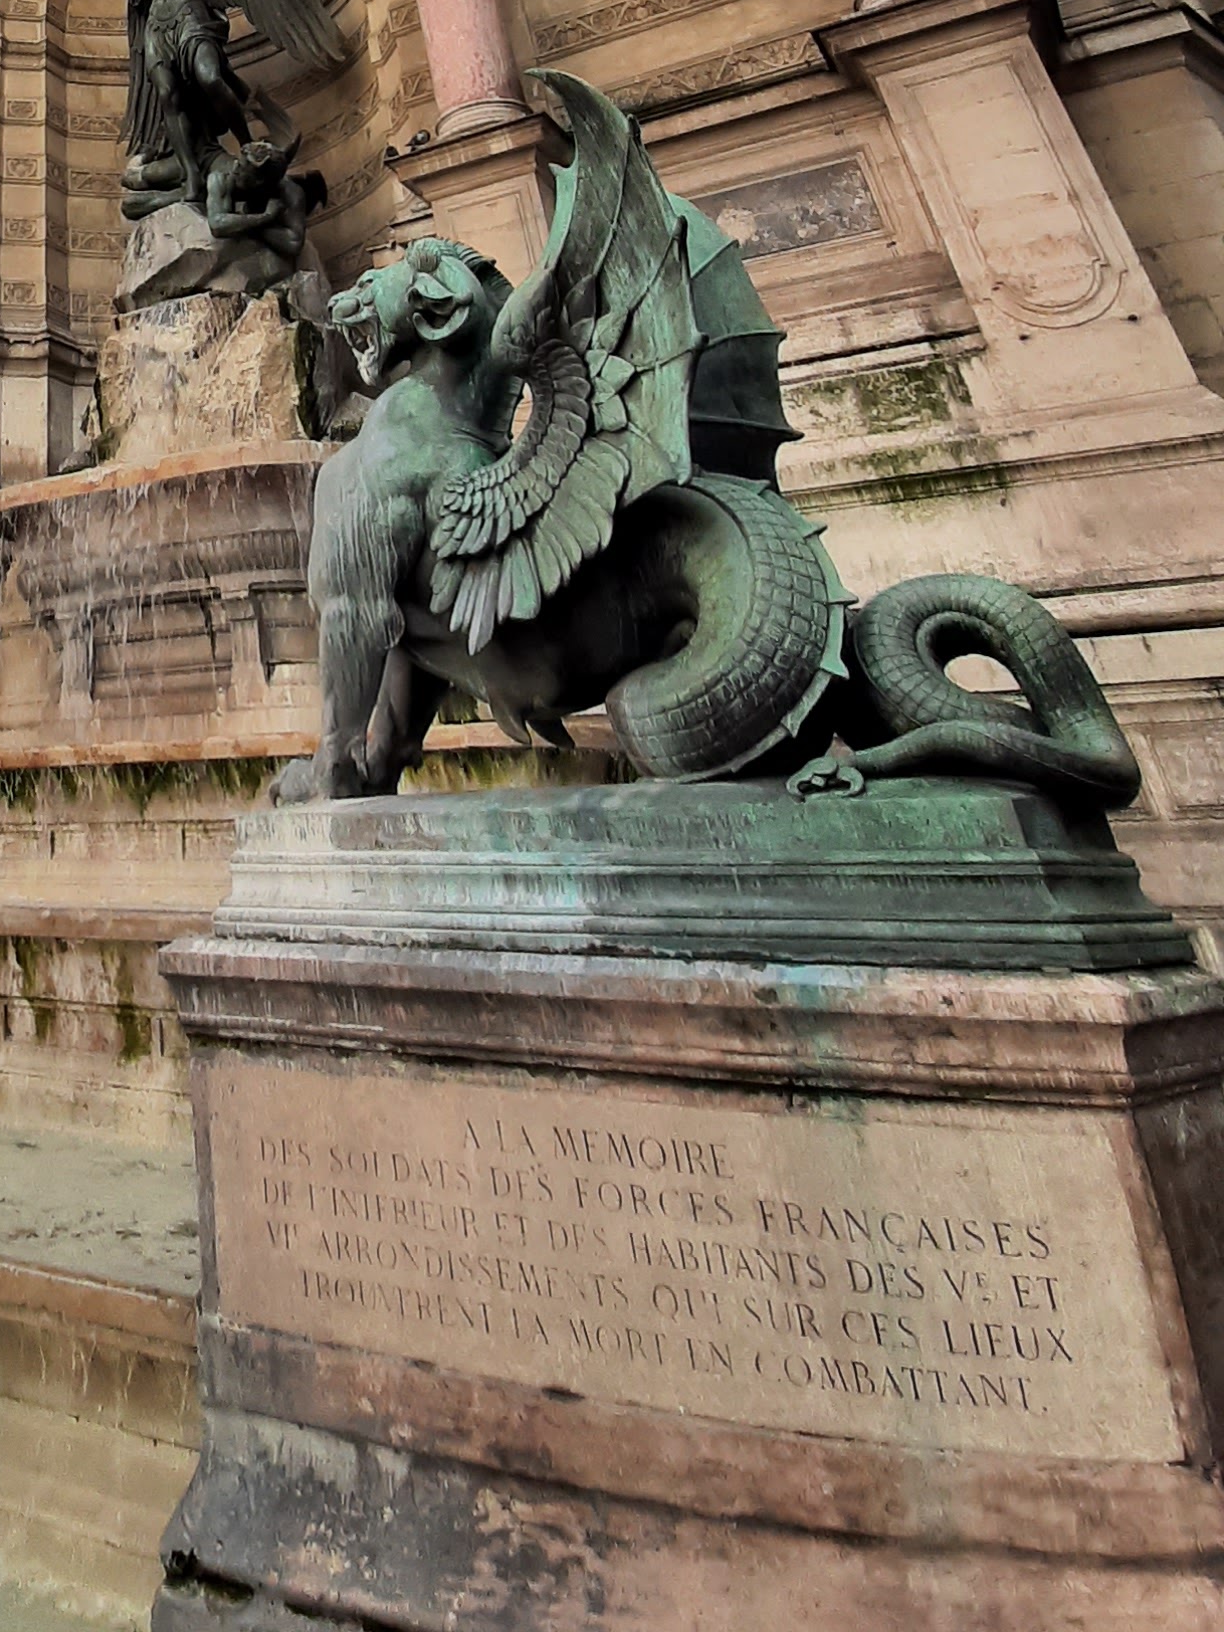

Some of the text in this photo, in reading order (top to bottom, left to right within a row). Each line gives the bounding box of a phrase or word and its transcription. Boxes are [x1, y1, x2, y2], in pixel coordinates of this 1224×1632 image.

[260, 1136, 1051, 1260] DES SOLDATS DES FORCES FRANÇAISES
[463, 1119, 480, 1150] A
[496, 1119, 537, 1156] LA
[263, 1177, 293, 1207] DE
[496, 1212, 528, 1247] ET
[549, 1220, 609, 1259] DES
[629, 1232, 827, 1291] HABITANTS
[846, 1258, 925, 1301] DES
[1013, 1275, 1060, 1313] ET
[317, 1230, 629, 1308] ARRONDISSEMENTS
[653, 1284, 724, 1325] QUI
[745, 1299, 823, 1339] SUR
[842, 1311, 919, 1350] CES
[943, 1319, 1074, 1363] LIEUX
[512, 1307, 549, 1345] LA
[568, 1318, 668, 1366] MORT
[687, 1338, 733, 1377] EN
